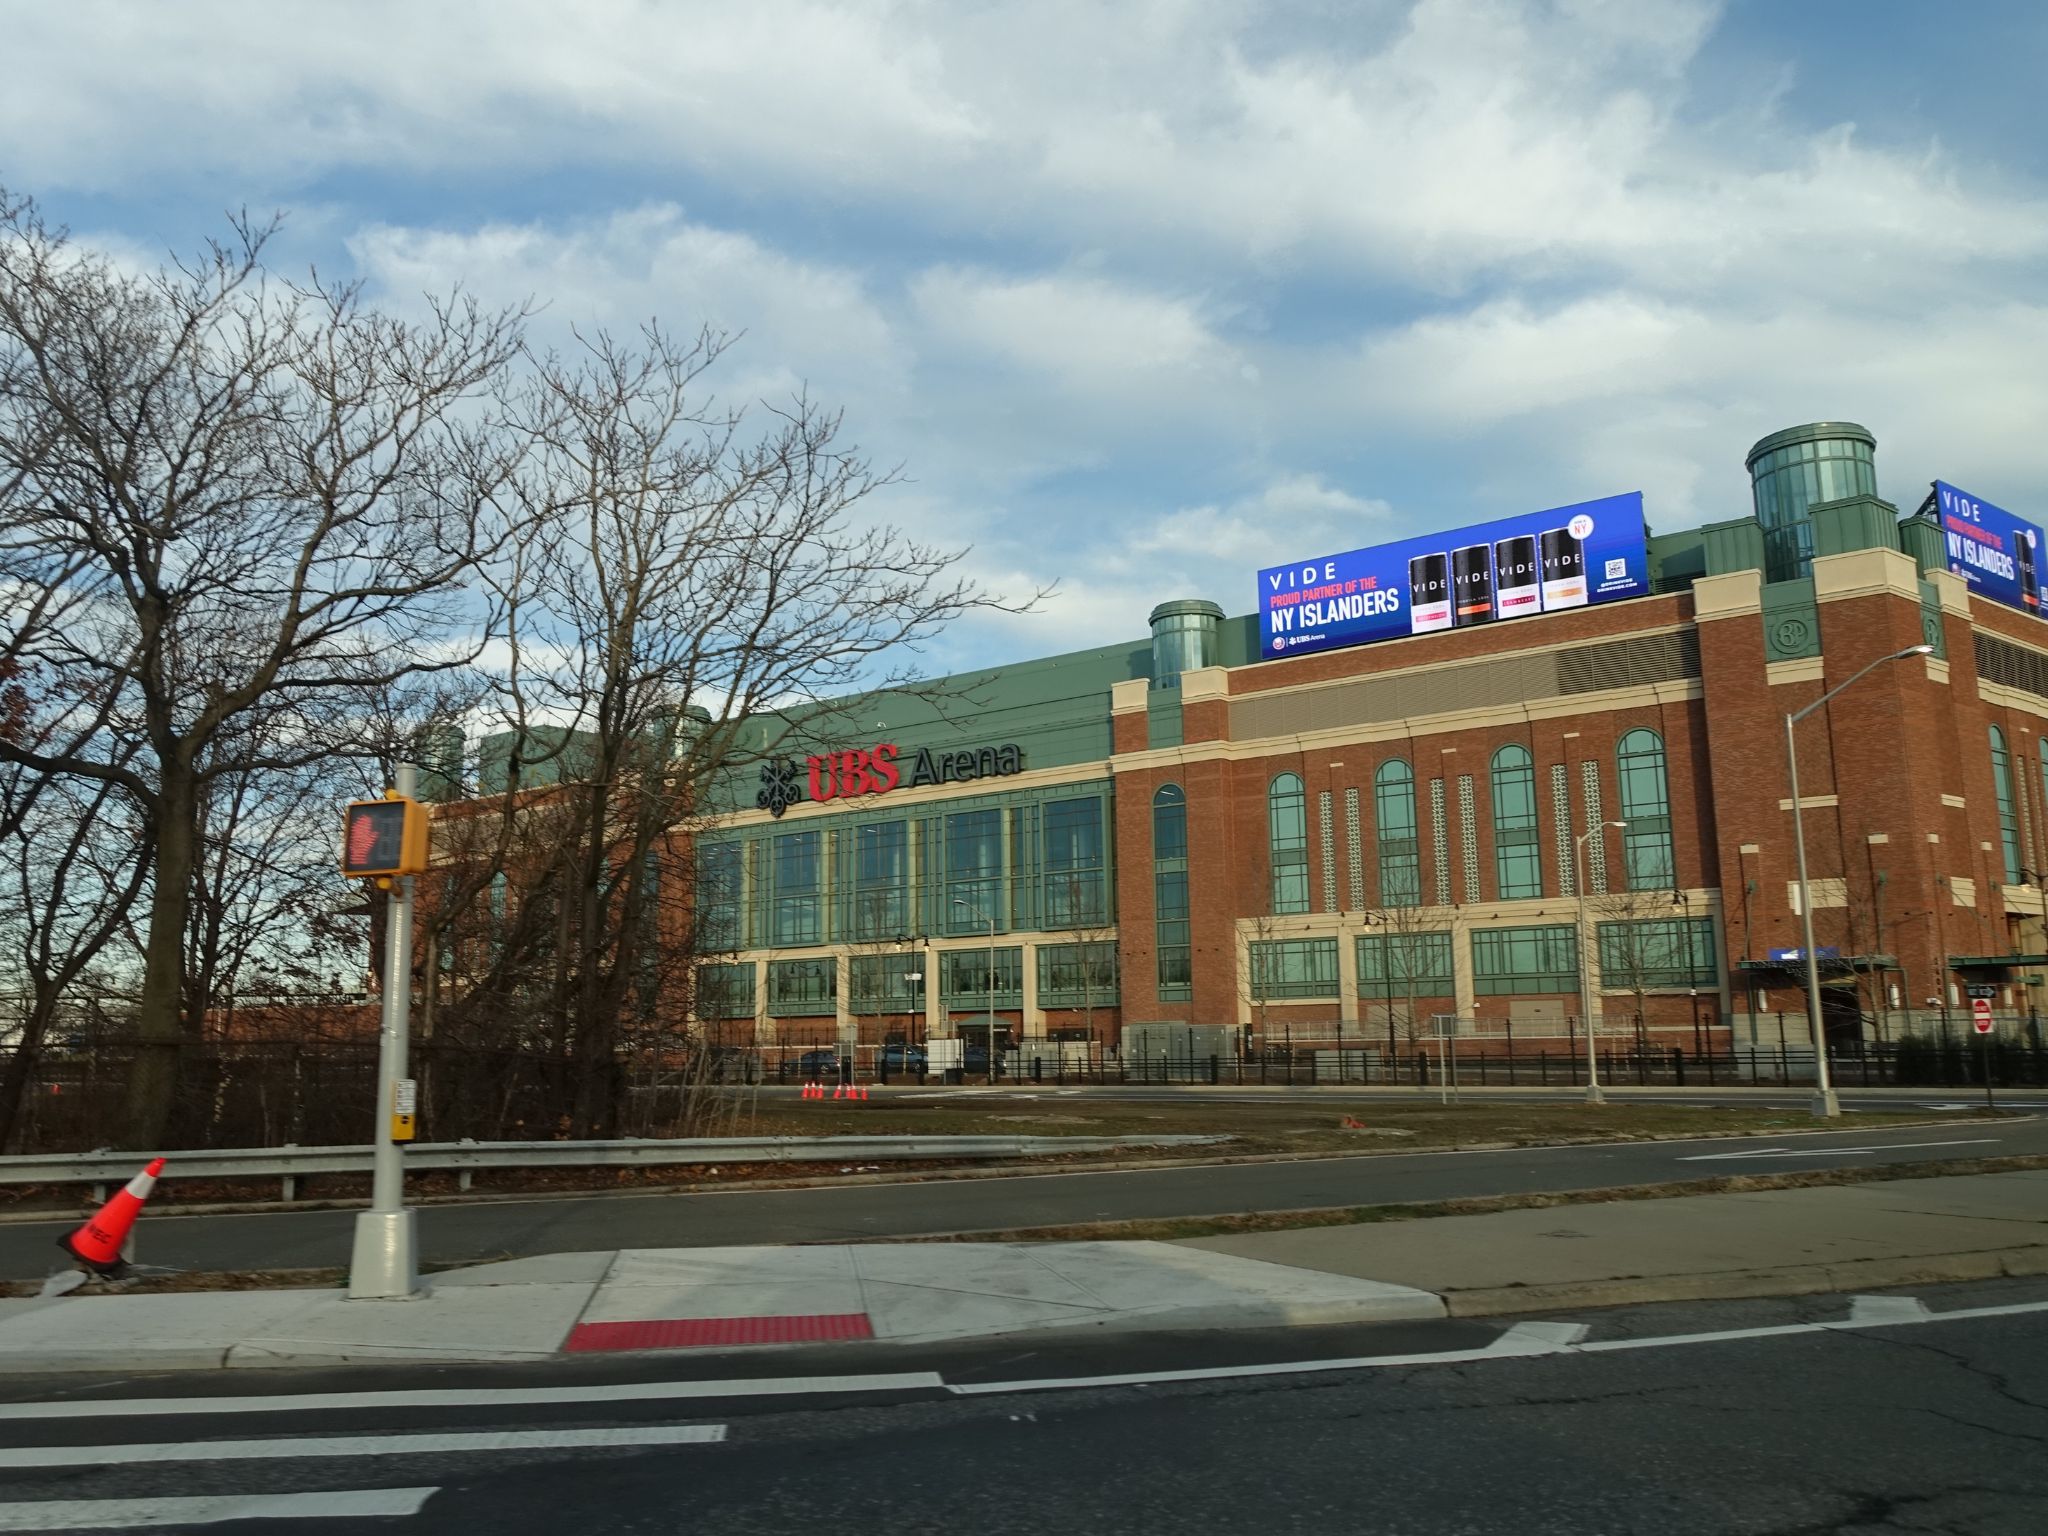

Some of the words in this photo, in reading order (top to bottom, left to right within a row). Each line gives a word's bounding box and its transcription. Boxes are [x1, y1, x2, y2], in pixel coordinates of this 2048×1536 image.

[1942, 490, 1981, 522] VIDE
[1574, 522, 1587, 535] NY
[1544, 553, 1580, 569] VIDE
[1947, 531, 1962, 559] NY
[1963, 537, 2015, 580] ISLANDERS
[1269, 562, 1336, 591] VIDE
[1455, 570, 1489, 585] VIDE
[1499, 561, 1534, 577] VIDE
[1270, 591, 1301, 609] PROUD
[1302, 583, 1343, 602] PARTNER
[1344, 579, 1358, 594] OF
[1359, 575, 1378, 591] THE
[1413, 578, 1446, 593] VIDE
[1271, 607, 1294, 634] NY
[1299, 587, 1400, 628] ISLANDERS
[1296, 634, 1311, 644] UBS
[1310, 633, 1326, 641] Arena
[806, 743, 900, 803] UBS
[908, 743, 1022, 788] Arena
